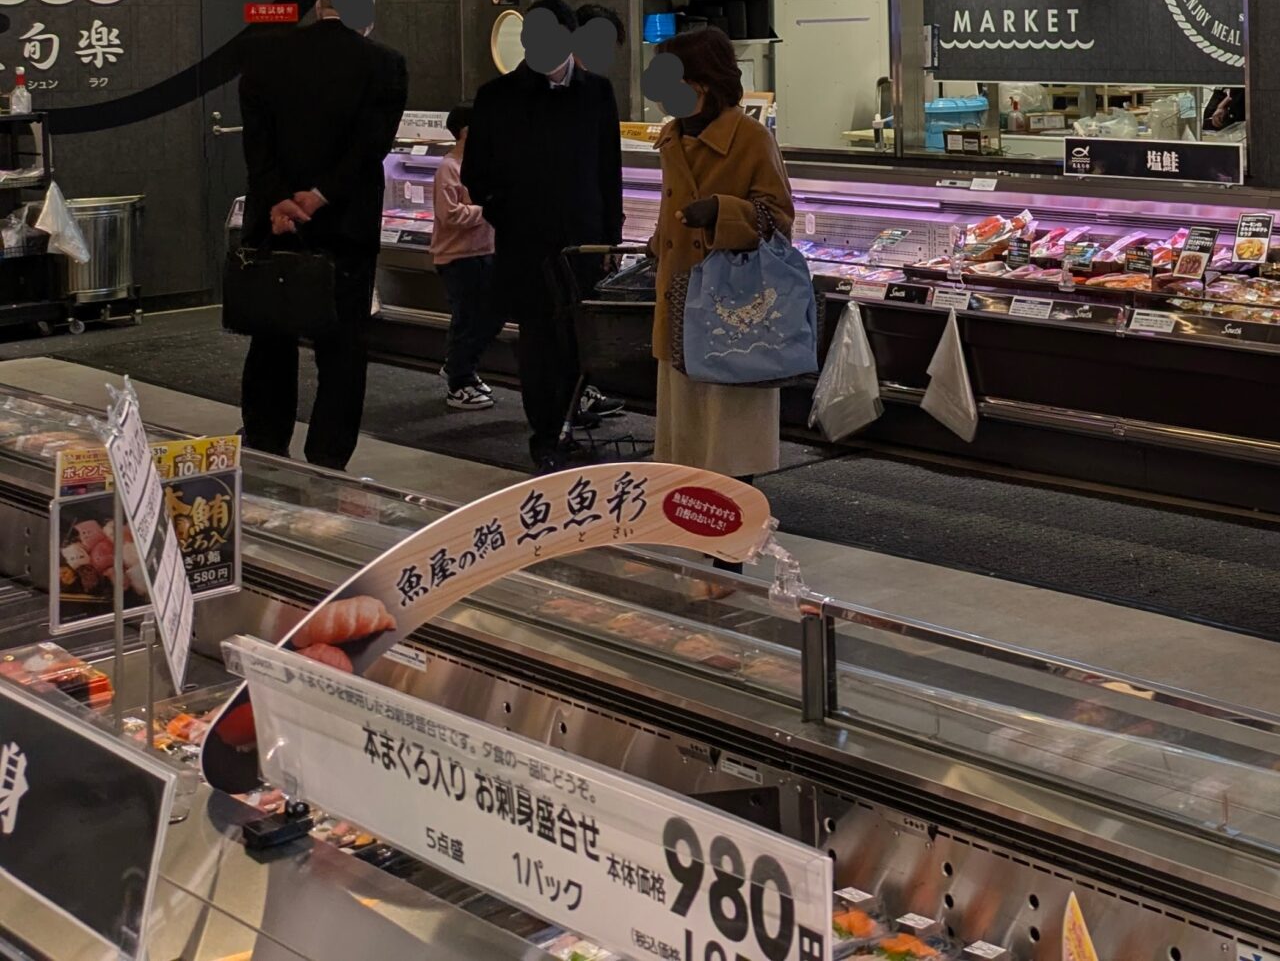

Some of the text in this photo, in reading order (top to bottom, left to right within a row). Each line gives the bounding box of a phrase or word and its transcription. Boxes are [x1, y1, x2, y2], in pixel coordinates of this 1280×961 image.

[952, 8, 1080, 33] MARKET
[1211, 20, 1242, 47] MEAL
[0, 20, 125, 71] 旬楽
[27, 77, 109, 90] シュン ラク
[1146, 150, 1180, 173] 塩鮭
[63, 463, 110, 479] ポイント
[671, 492, 736, 522] 魚屋がおすすめする
[675, 506, 728, 532] 自慢のおいしさ!
[395, 470, 650, 608] 魚屋の鮨 魚魚彩
[361, 723, 600, 862] 本まぐろ入り お刺身盛合せ
[425, 826, 584, 912] 5点盛 1パック
[605, 852, 667, 907] 本体価格
